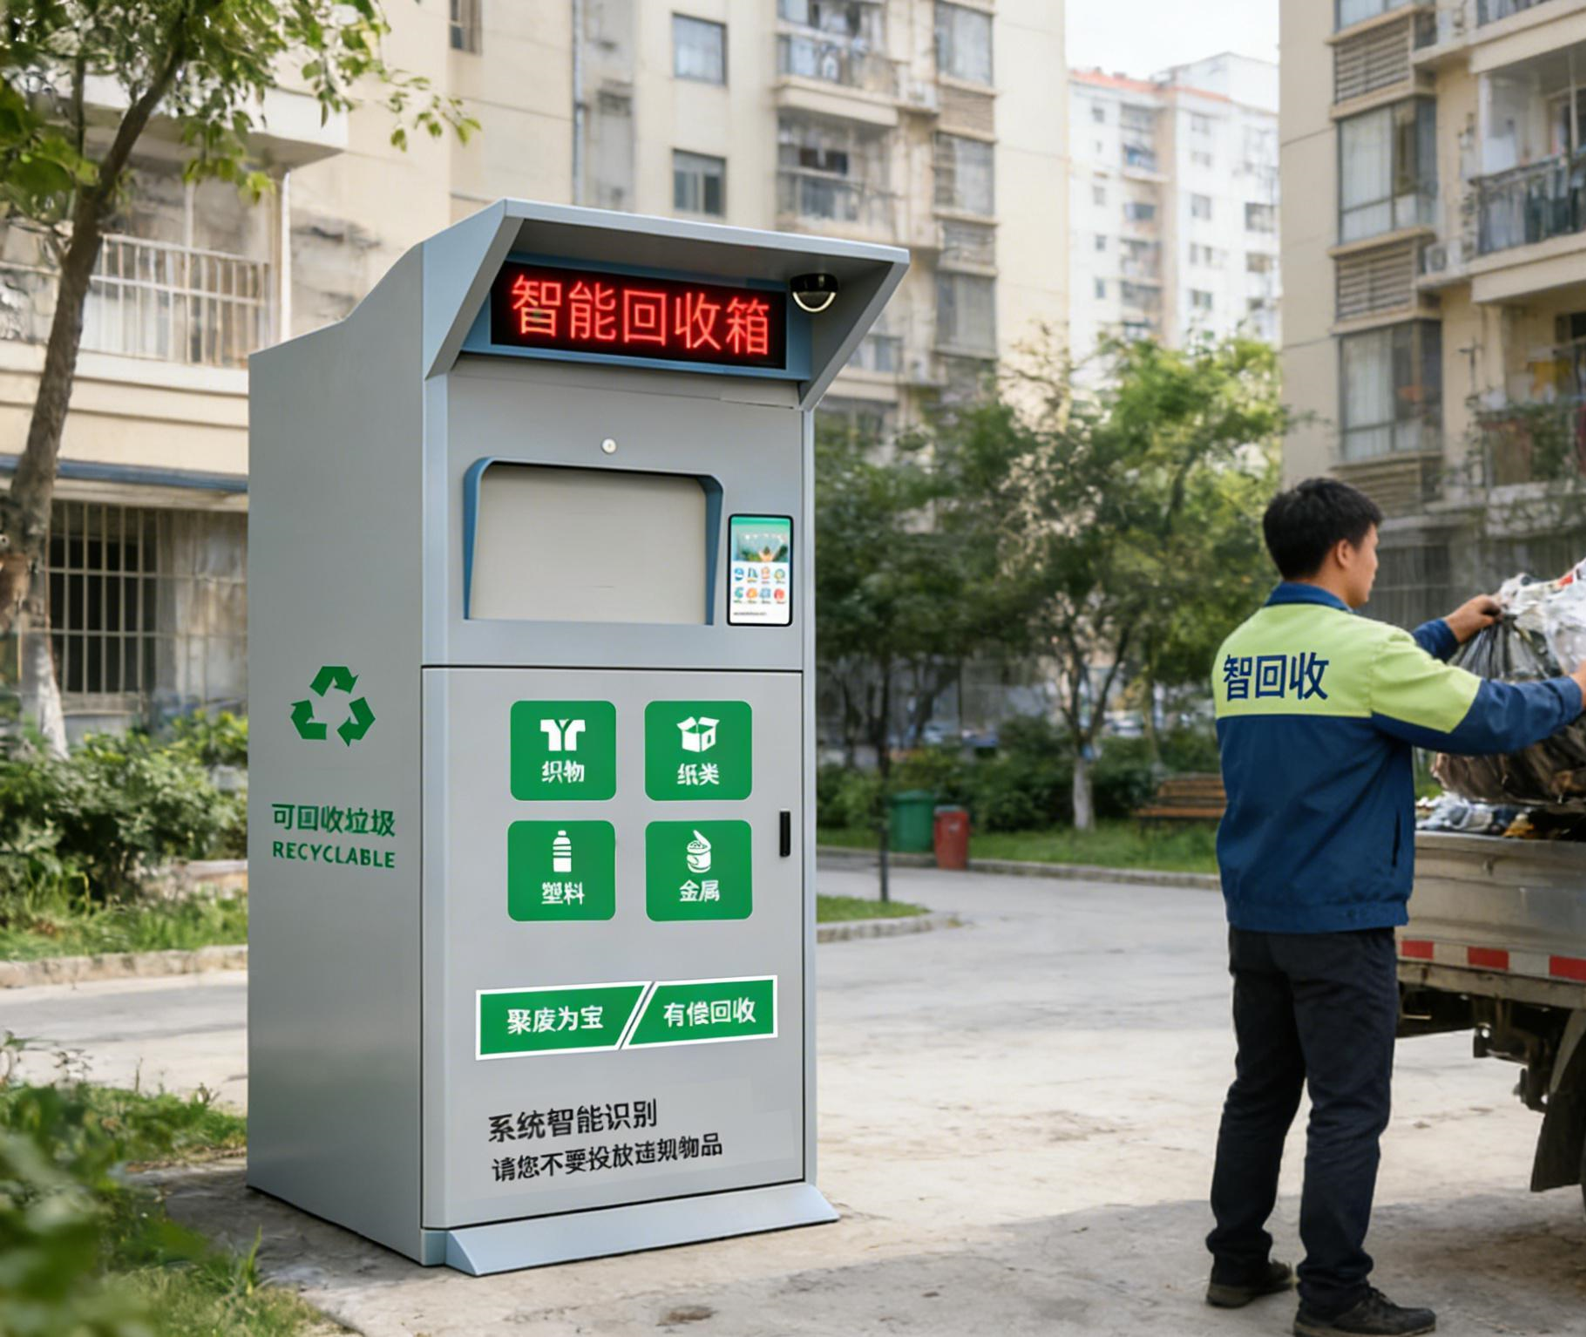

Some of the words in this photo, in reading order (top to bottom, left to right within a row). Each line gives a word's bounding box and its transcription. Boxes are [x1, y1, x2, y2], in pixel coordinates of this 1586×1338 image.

[511, 274, 770, 356] 智能回收箱
[1223, 652, 1330, 701] 智回收
[541, 760, 585, 783] 织物
[677, 763, 720, 786] 纸类
[271, 803, 396, 837] 可回收垃圾
[272, 840, 396, 869] RECYCLABLE
[541, 881, 585, 905] 塑料
[679, 879, 720, 902] 金属
[507, 1005, 604, 1035] 聚废为宝
[488, 1098, 657, 1143] 系统智能识别
